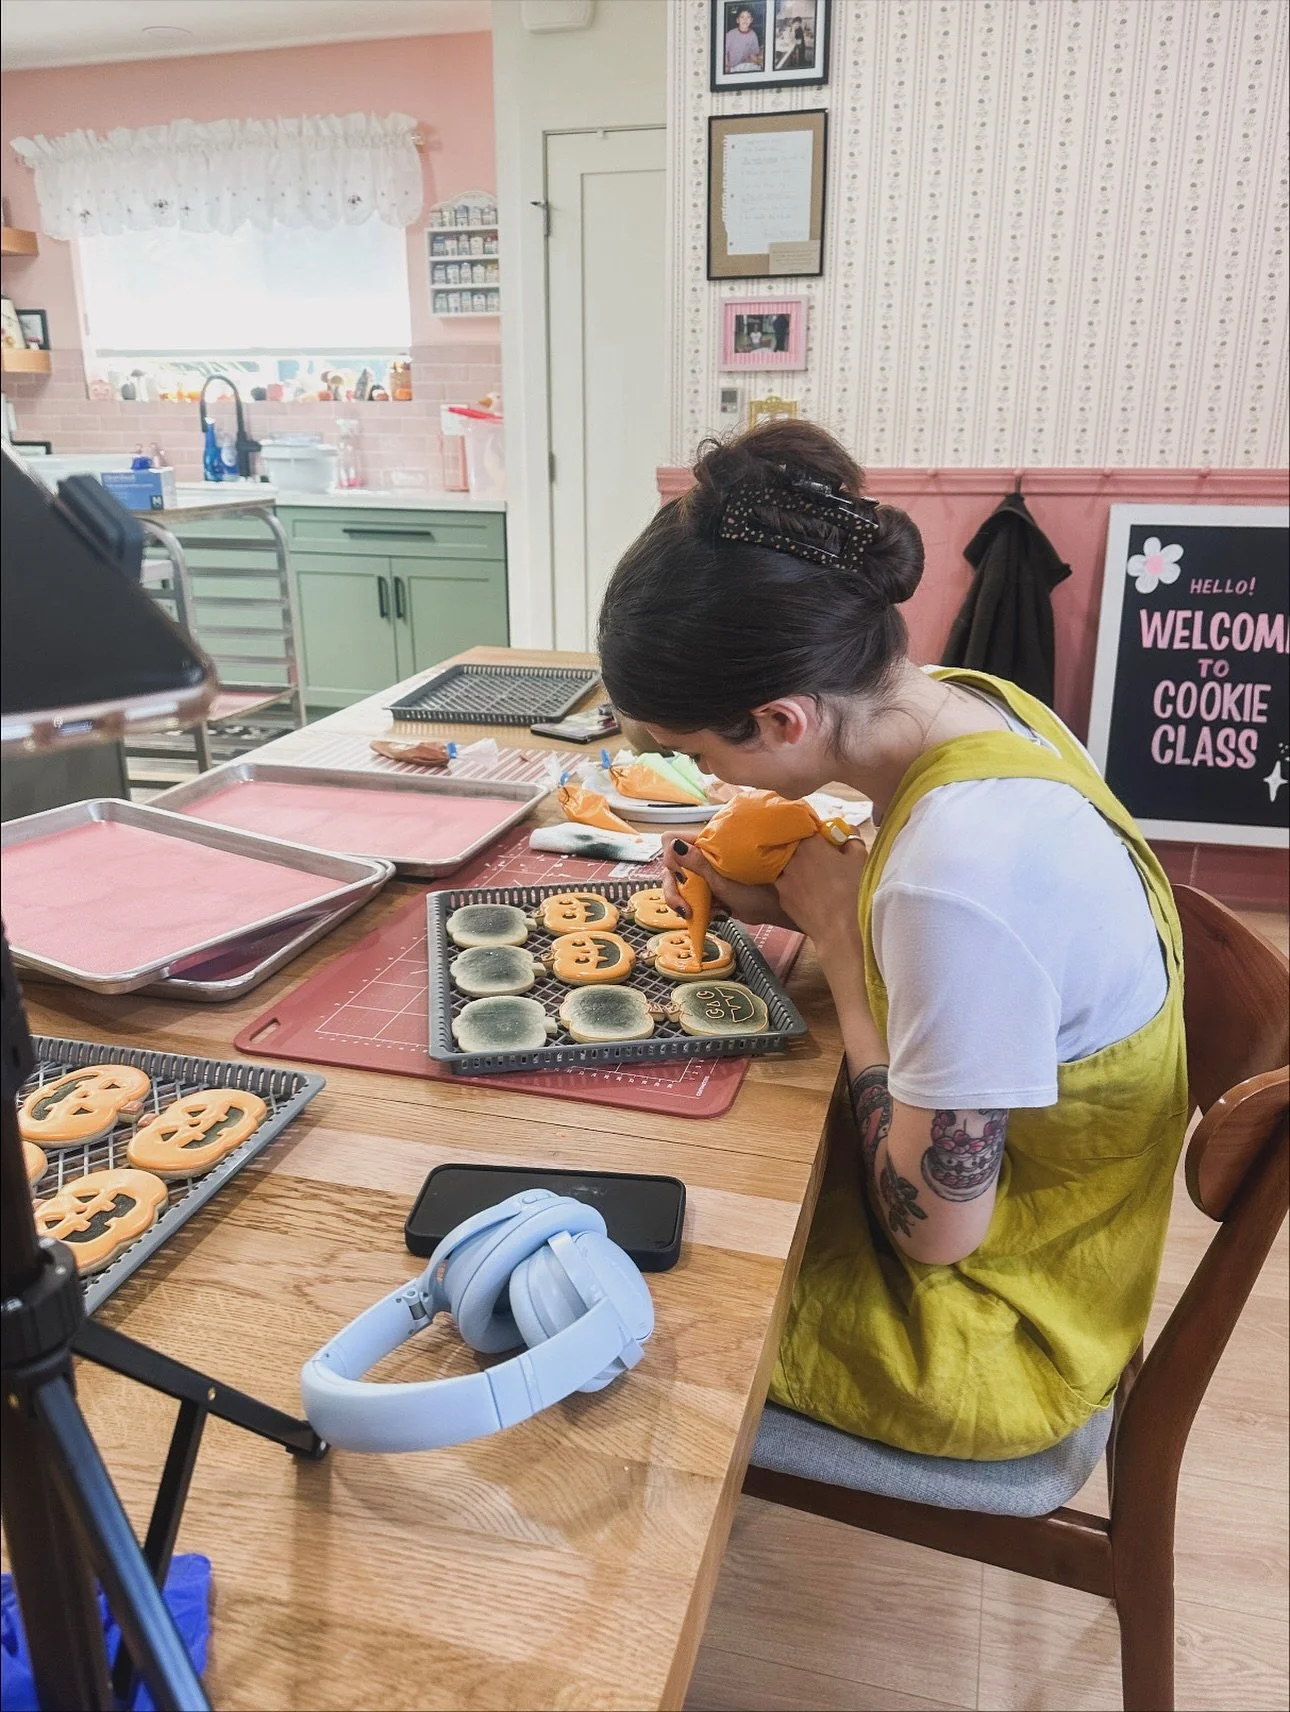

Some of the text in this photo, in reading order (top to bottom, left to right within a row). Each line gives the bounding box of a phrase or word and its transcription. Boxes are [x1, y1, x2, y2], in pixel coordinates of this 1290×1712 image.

[1190, 577, 1256, 596] HELLO!
[1139, 608, 1289, 654] WELCOM
[1198, 658, 1230, 678] TO
[1153, 680, 1271, 723] COOKIE
[1151, 724, 1258, 769] CLASS
